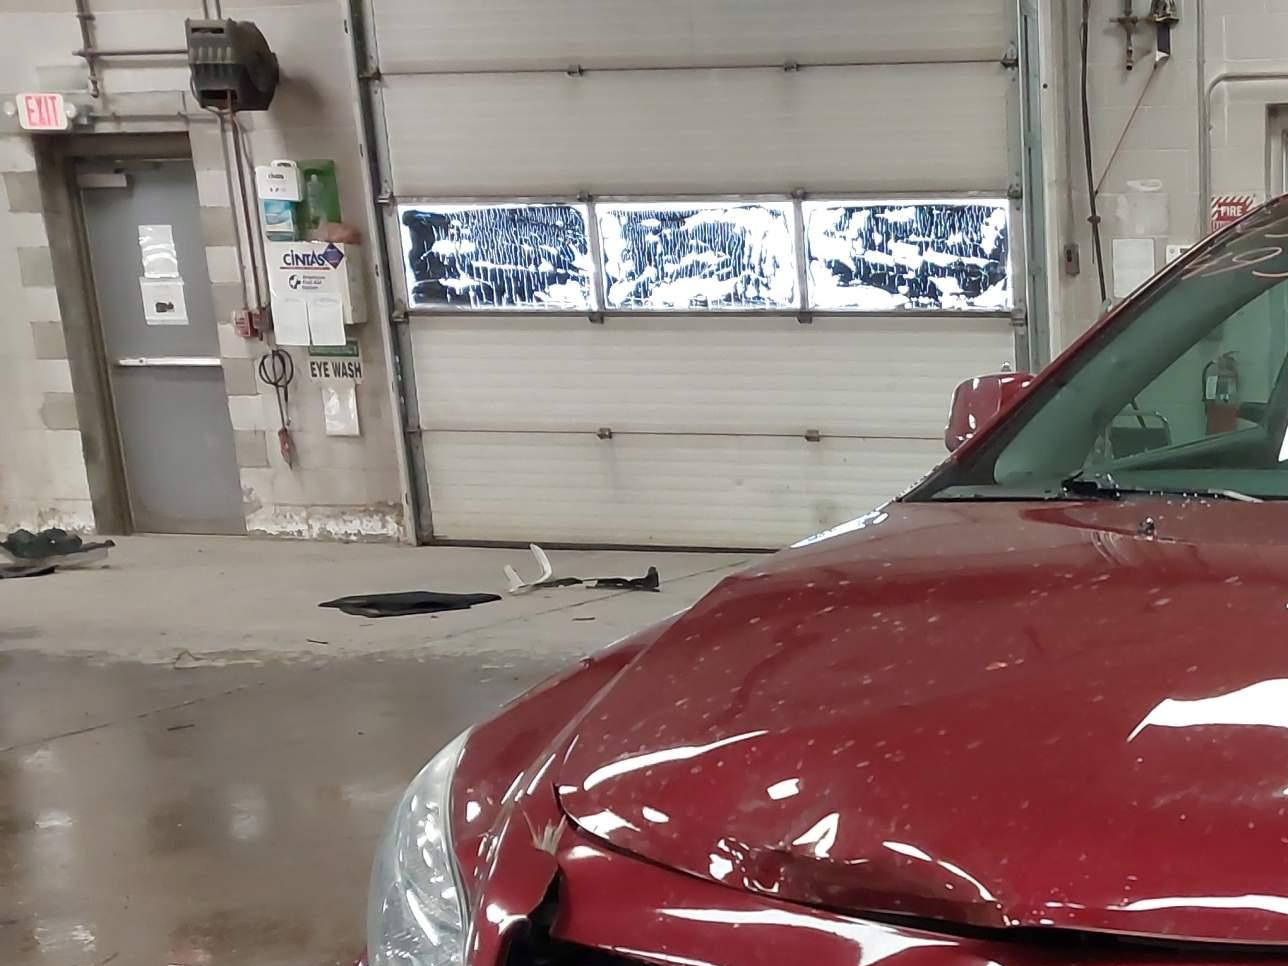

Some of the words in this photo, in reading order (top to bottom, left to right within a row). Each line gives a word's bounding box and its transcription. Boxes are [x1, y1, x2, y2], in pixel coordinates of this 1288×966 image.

[24, 95, 59, 127] EXIT
[1219, 205, 1244, 217] FIRE
[310, 360, 331, 378] EYE
[331, 360, 363, 379] WASH
